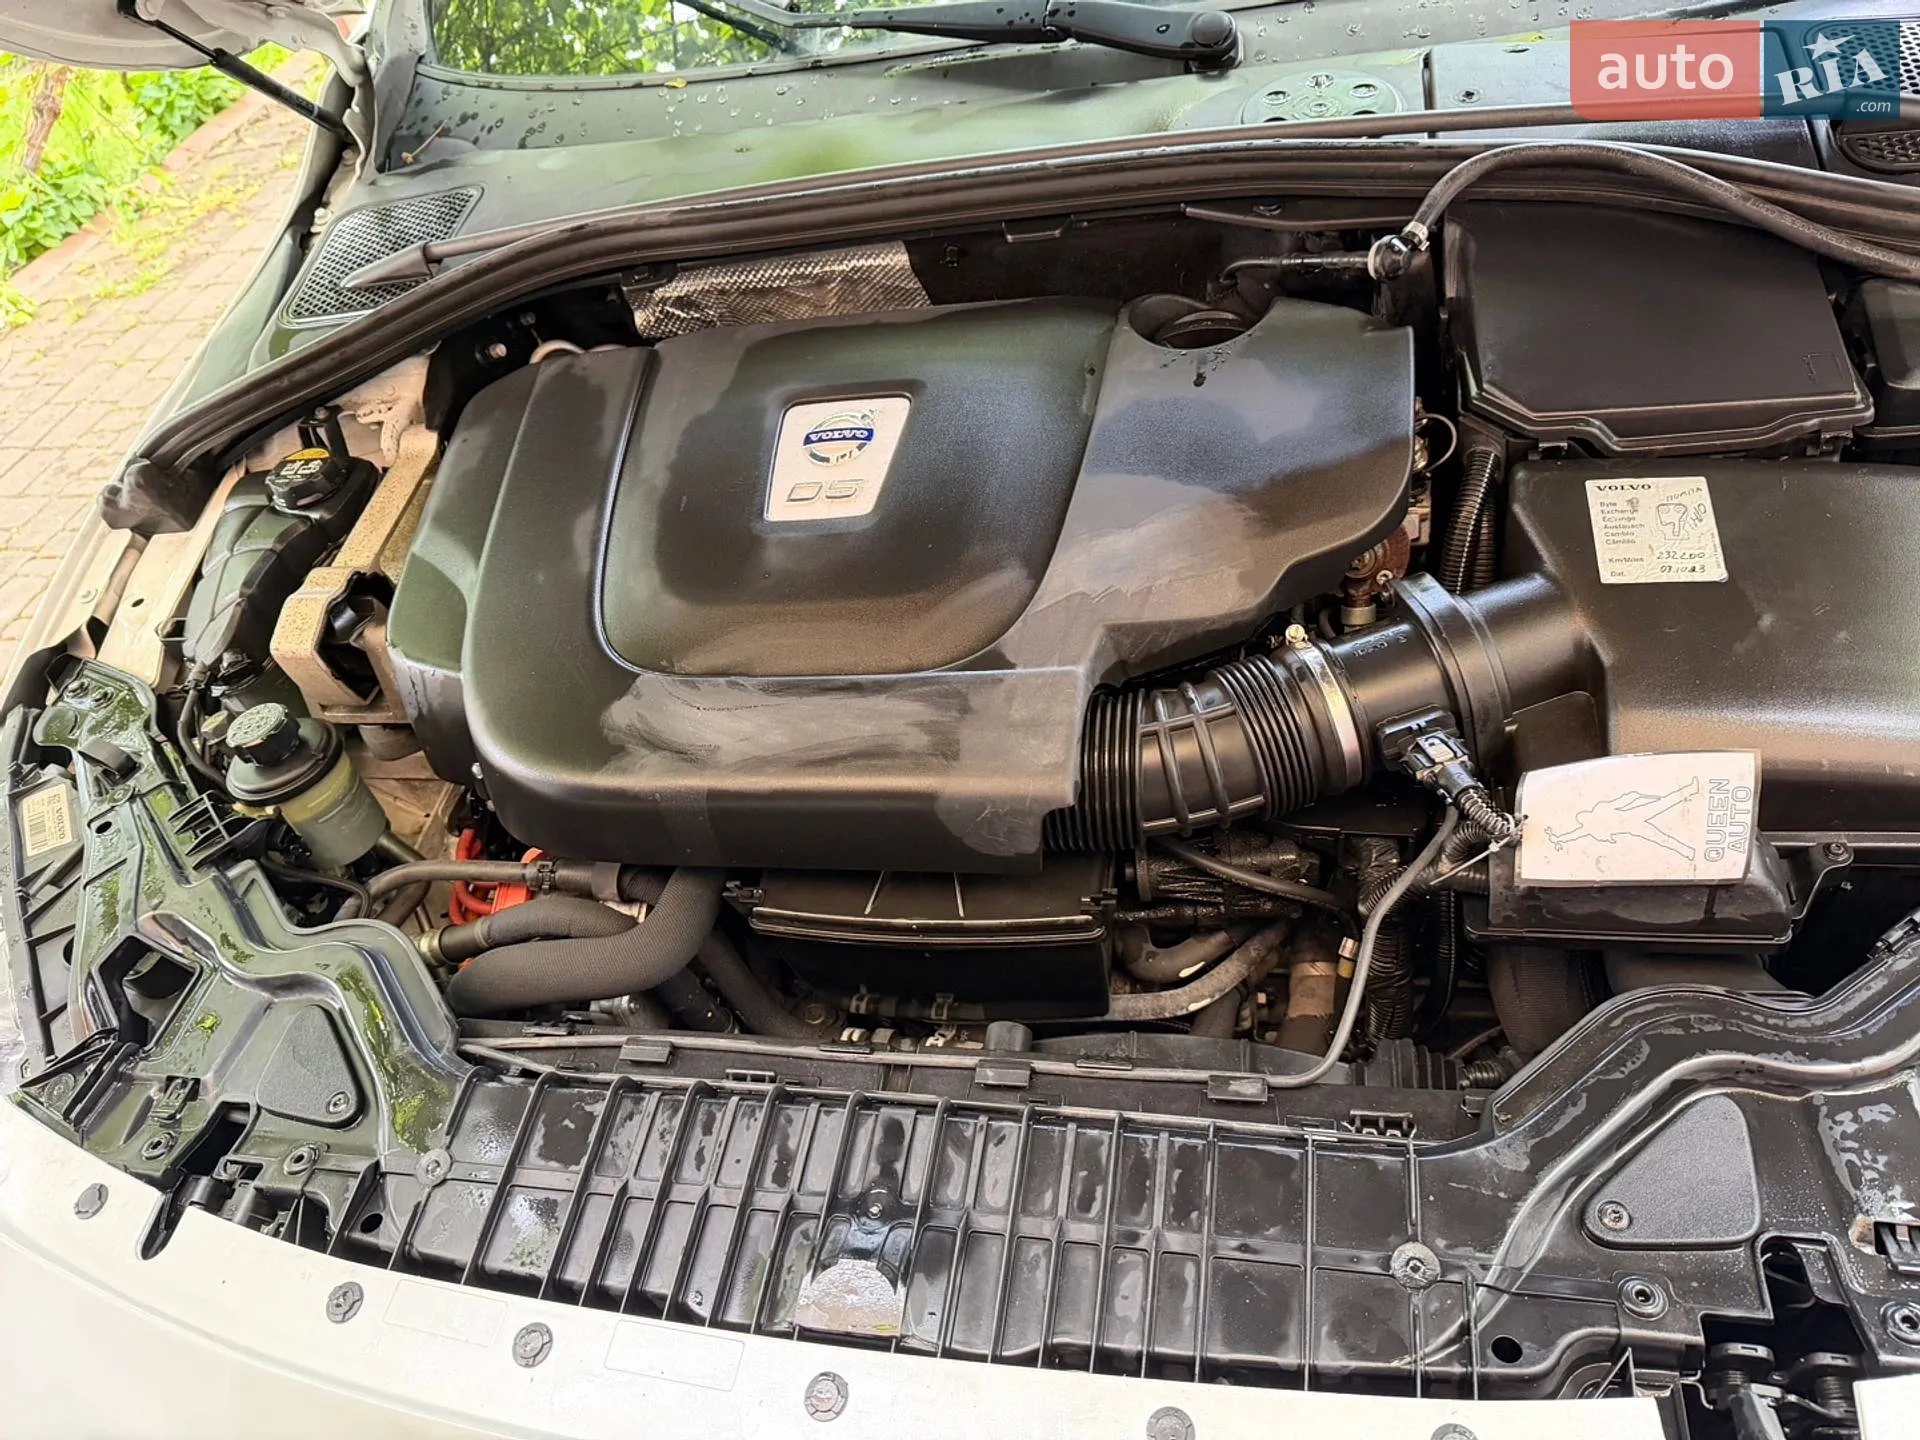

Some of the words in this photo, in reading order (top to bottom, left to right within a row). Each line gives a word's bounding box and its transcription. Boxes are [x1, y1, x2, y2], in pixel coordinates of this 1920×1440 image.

[808, 430, 868, 441] VOLVO
[785, 478, 865, 503] D5
[1594, 483, 1652, 492] VOLVO
[55, 806, 66, 840] VOLVO
[1704, 778, 1729, 862] QUEEN
[1727, 786, 1752, 854] AUTO
